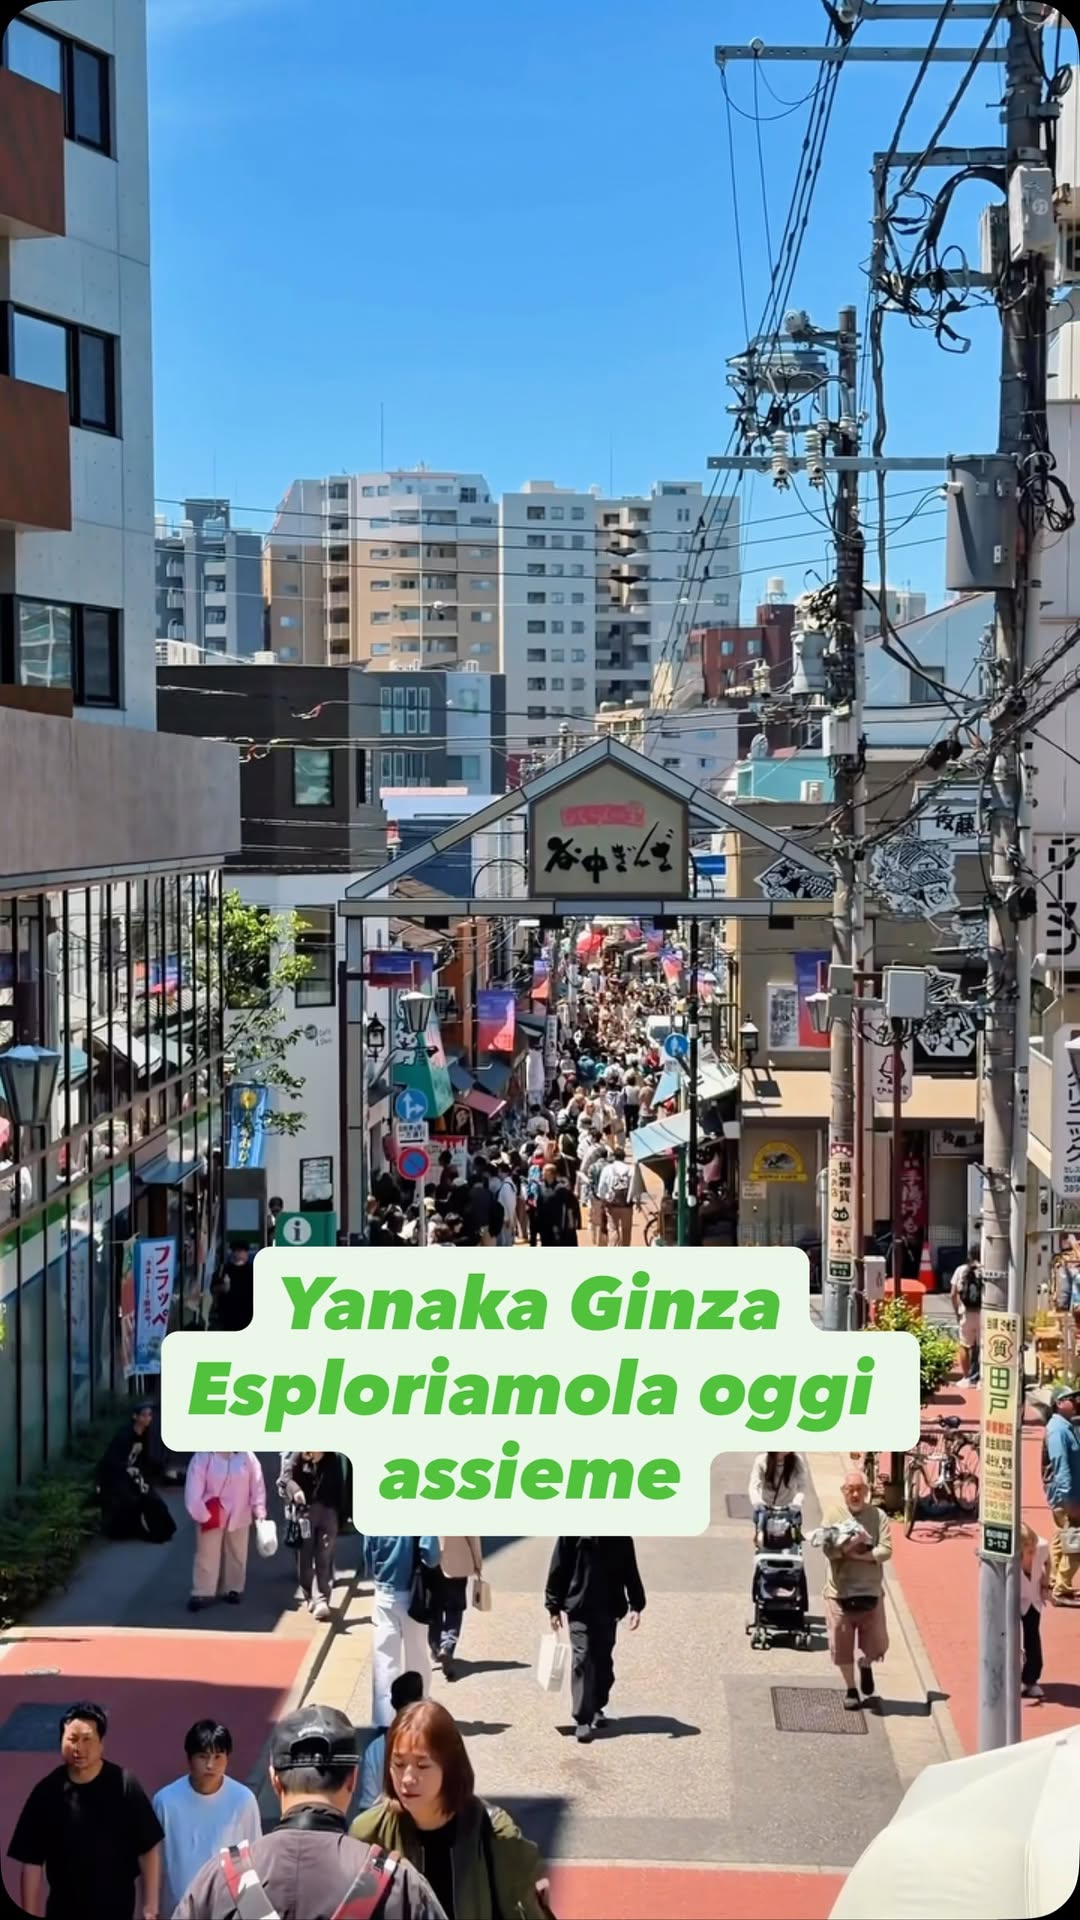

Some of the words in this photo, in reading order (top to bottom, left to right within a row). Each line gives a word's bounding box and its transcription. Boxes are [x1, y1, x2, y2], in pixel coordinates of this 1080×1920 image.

[544, 821, 674, 884] 谷中ぎんざ
[152, 1245, 170, 1325] フラッペ
[986, 1538, 1008, 1550] 3-13
